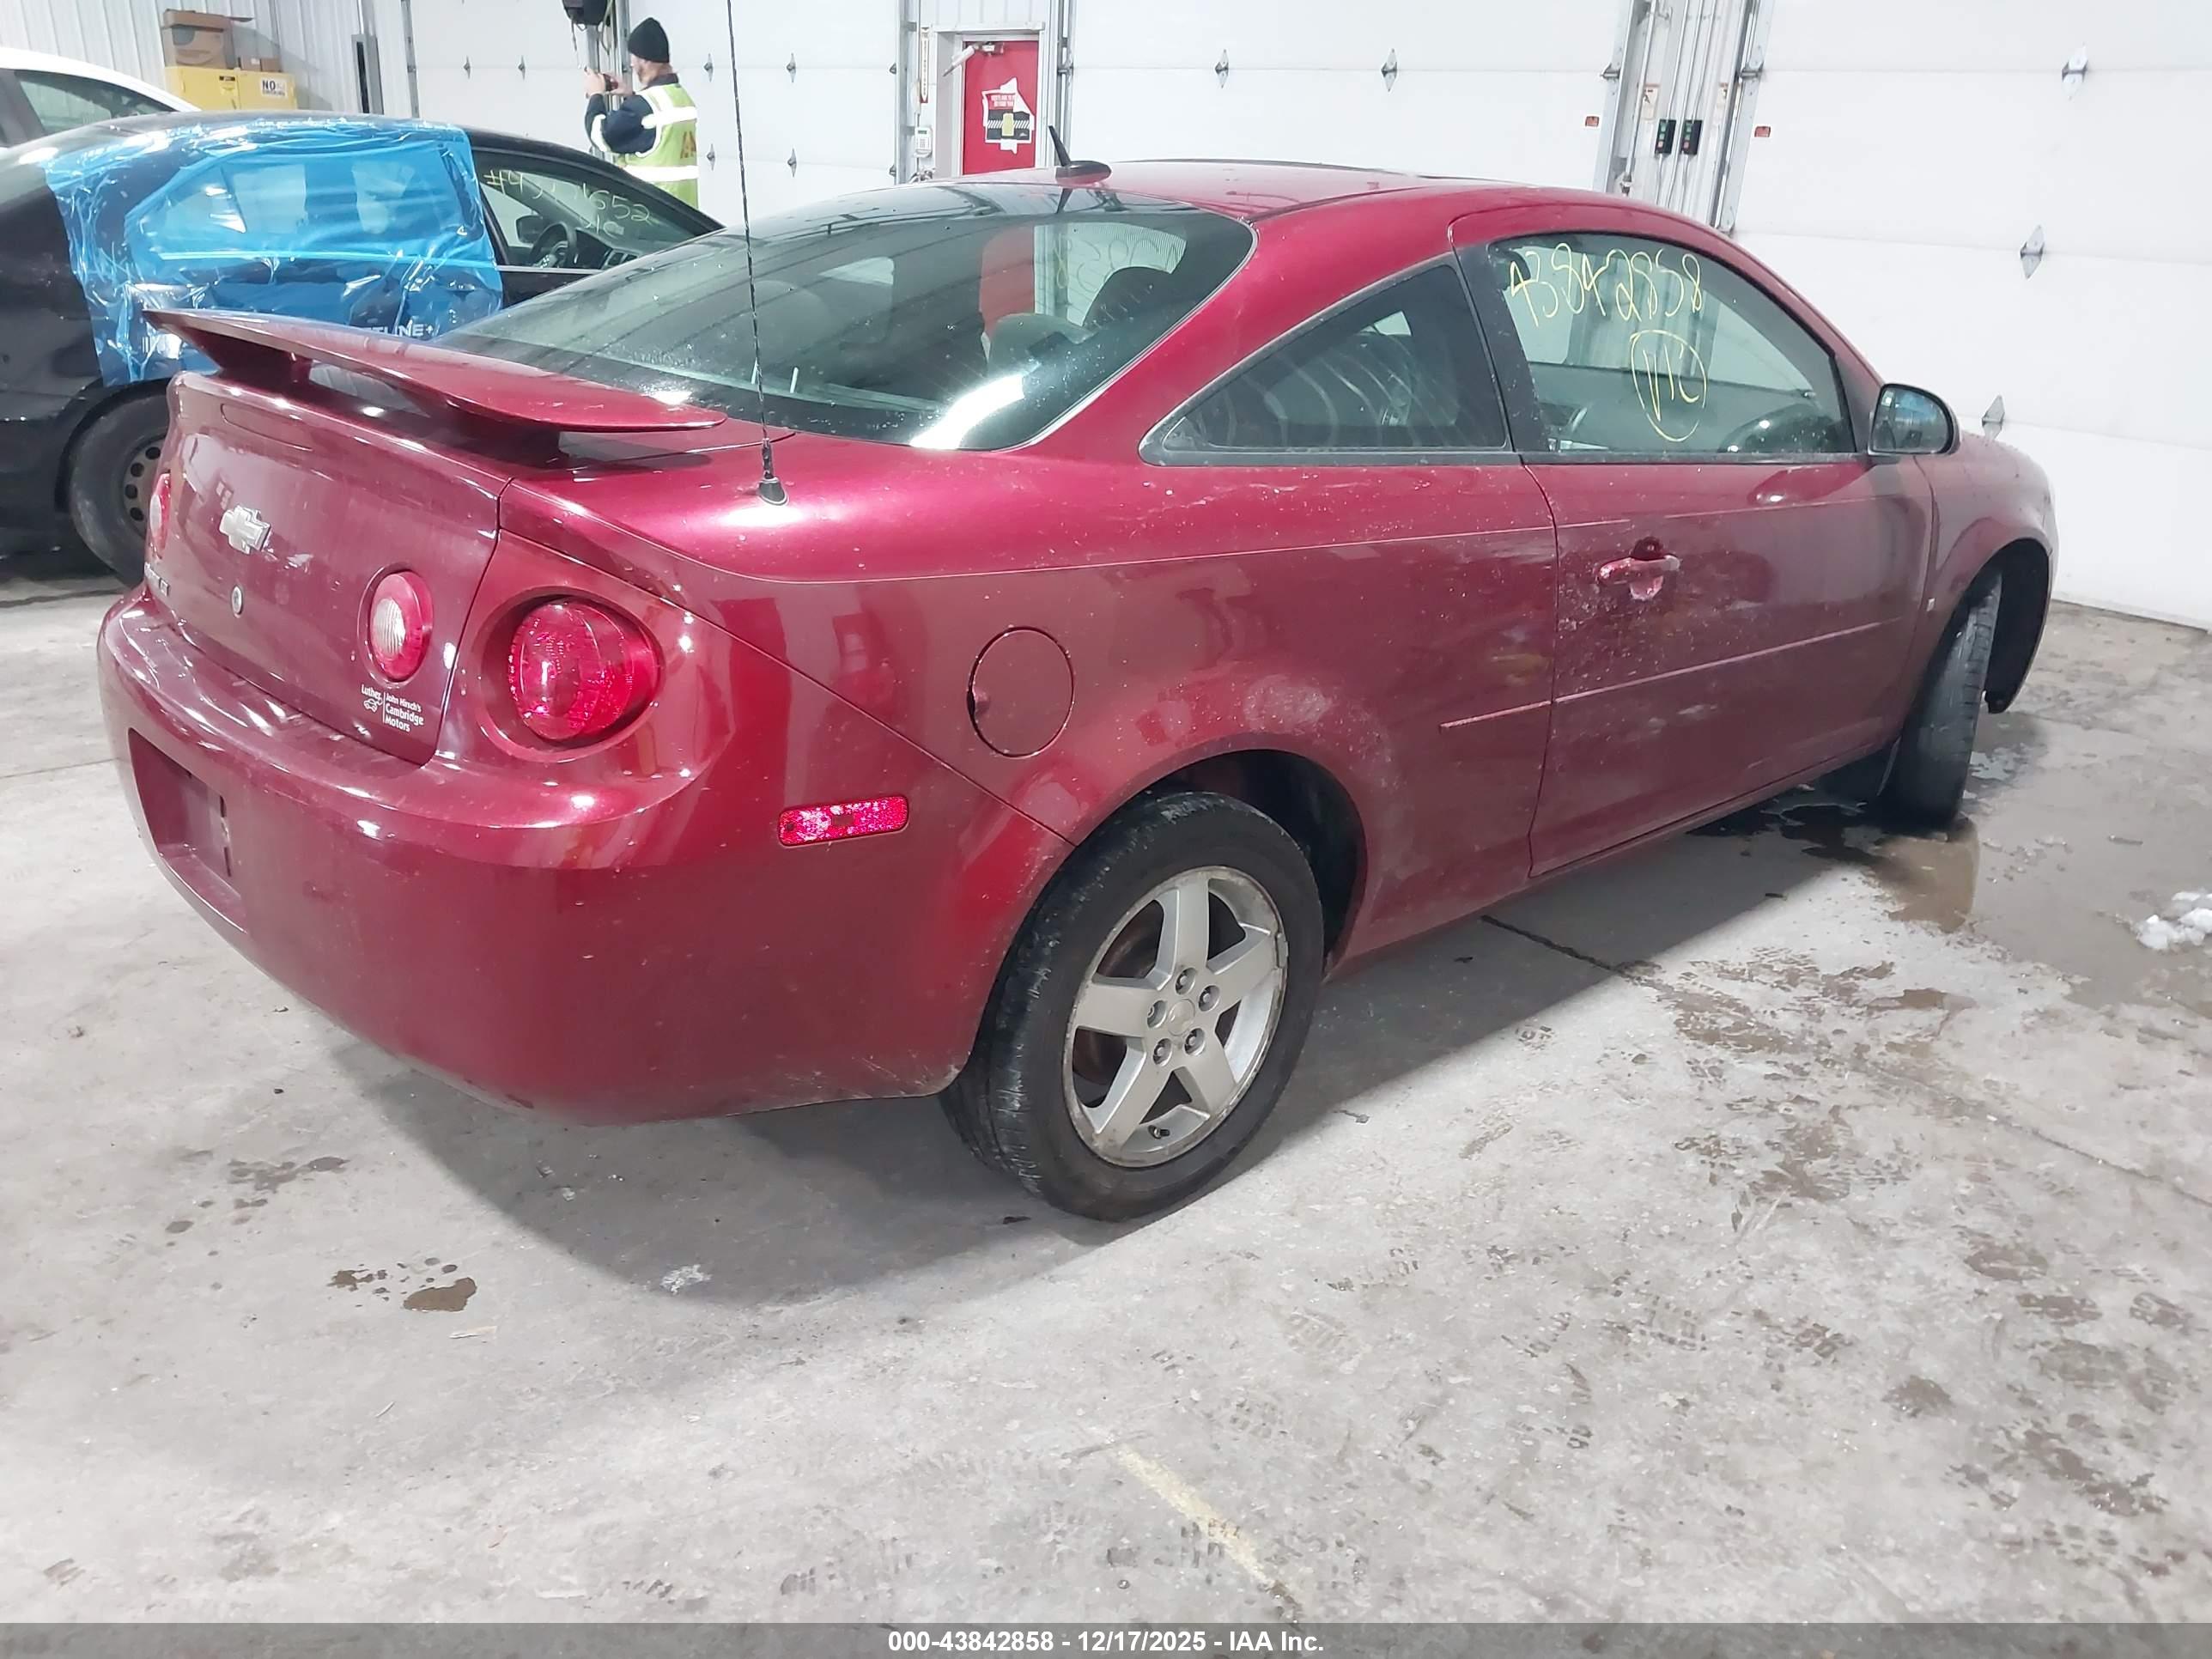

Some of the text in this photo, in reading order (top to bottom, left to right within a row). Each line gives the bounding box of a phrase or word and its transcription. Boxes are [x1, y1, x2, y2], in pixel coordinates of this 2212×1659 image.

[262, 80, 276, 90] NO
[1510, 242, 1703, 327] 43842858
[361, 684, 381, 700] Luther
[386, 692, 422, 713] John Hirsch's
[385, 714, 410, 732] Motors
[386, 702, 424, 726] Cambridge
